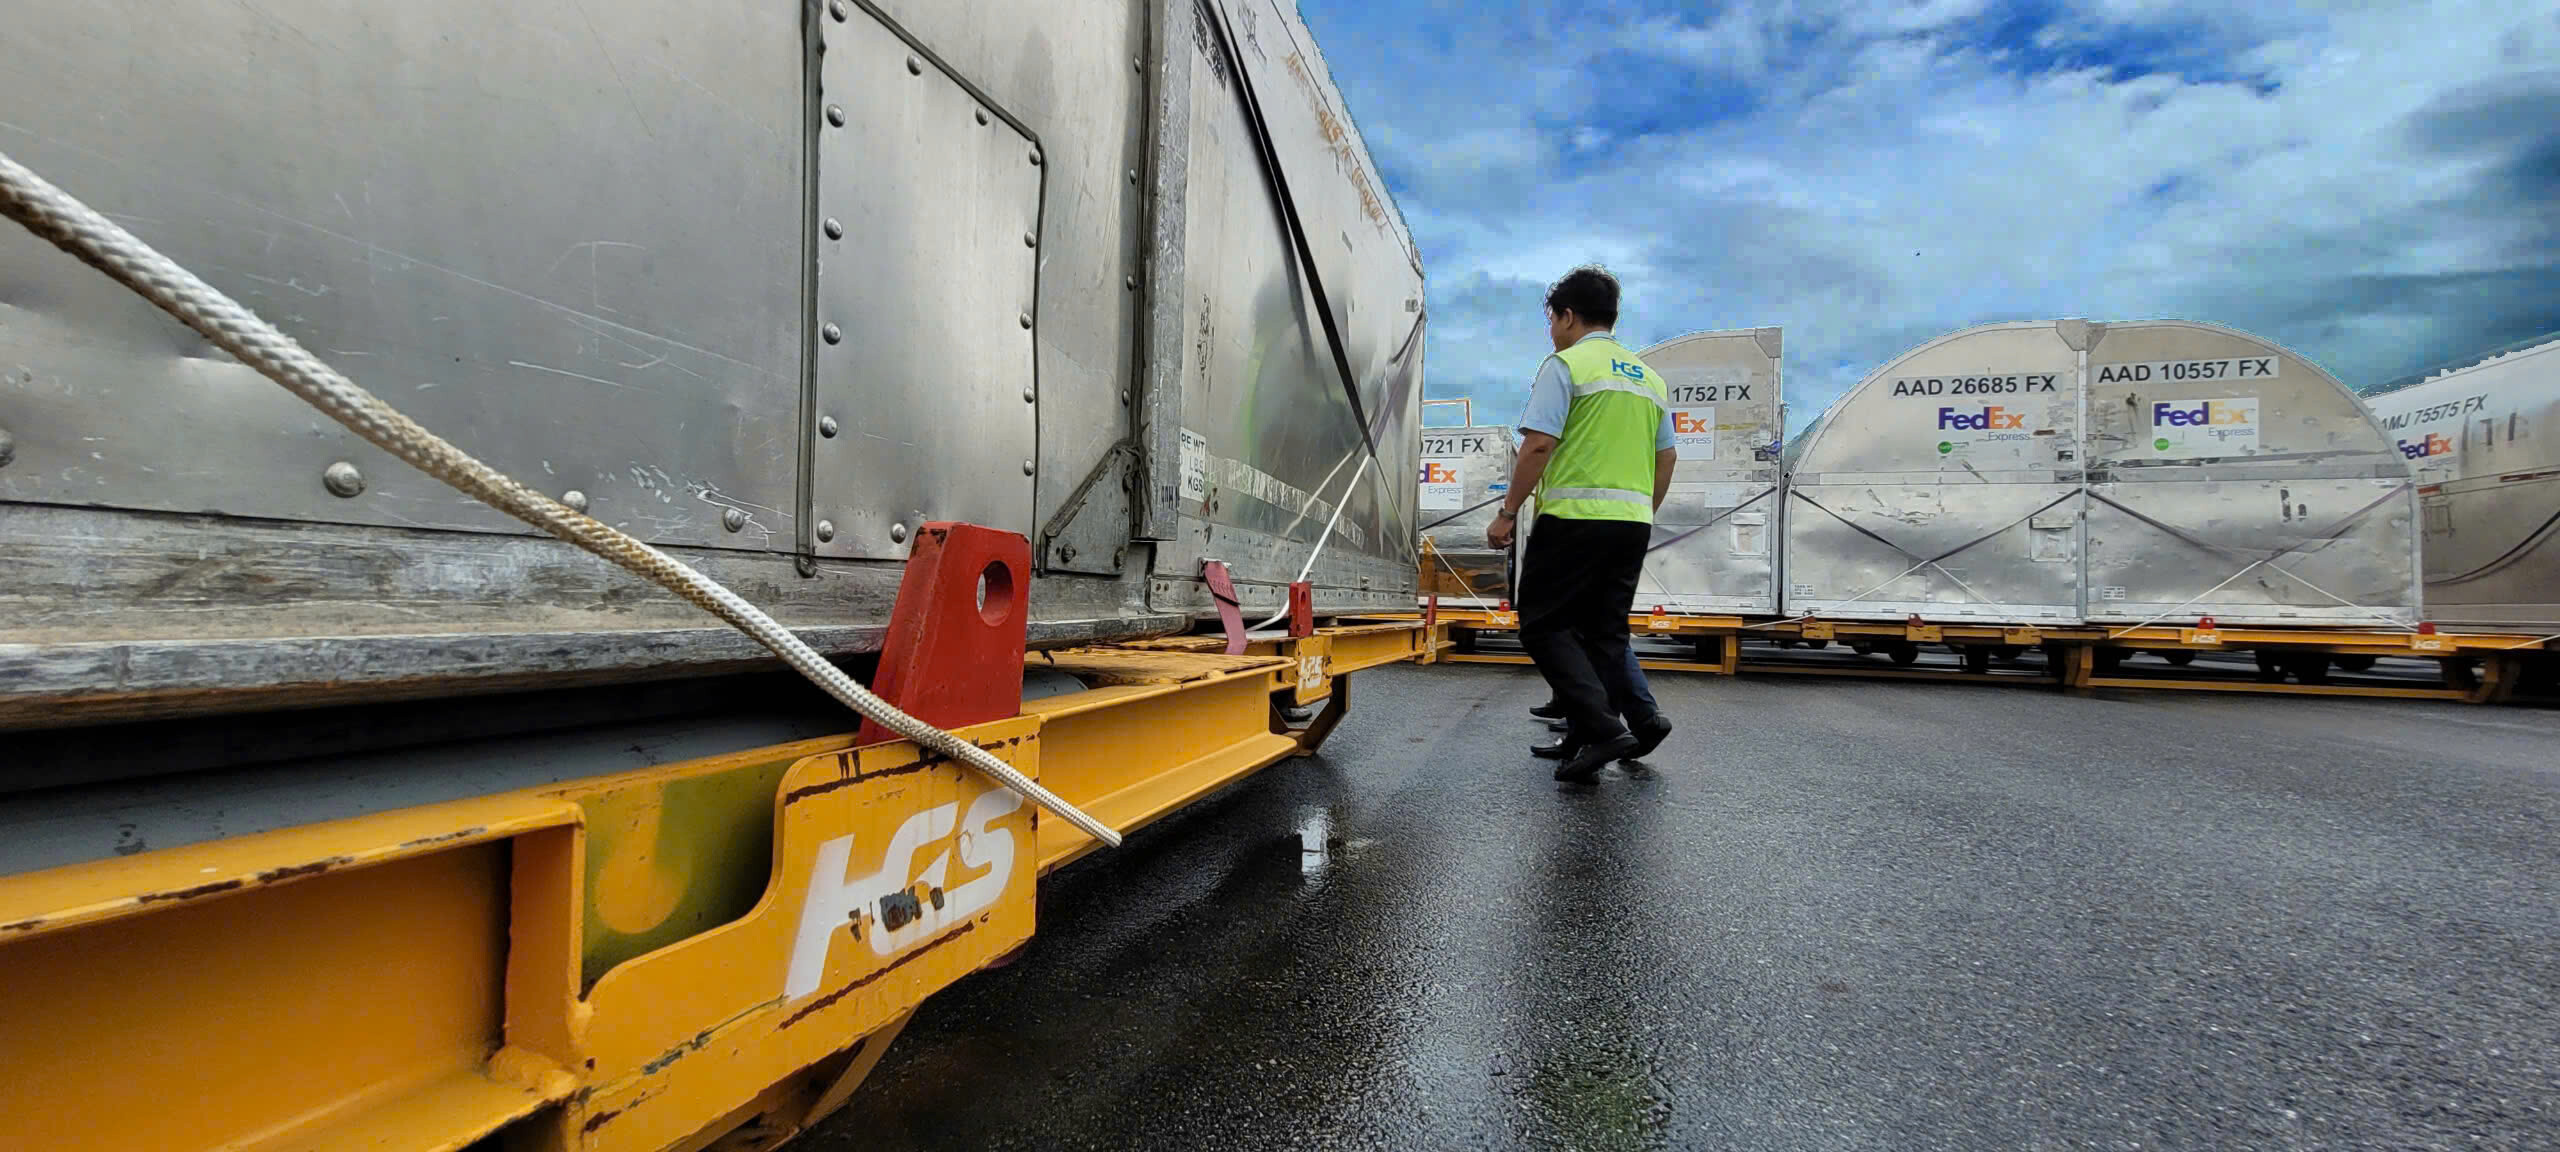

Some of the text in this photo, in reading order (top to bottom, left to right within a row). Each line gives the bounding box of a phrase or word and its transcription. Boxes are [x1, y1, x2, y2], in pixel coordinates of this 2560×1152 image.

[2098, 358, 2273, 383] AAD 10557 FX
[1672, 384, 1751, 402] 1752 FX
[1893, 375, 2056, 397] AAD 26685 FX
[1938, 406, 2024, 431] FedEx
[2154, 401, 2249, 427] FedEx
[2414, 400, 2461, 425] 75575
[2463, 393, 2488, 414] FX
[1675, 435, 1712, 446] Express
[1988, 431, 2031, 442] Express
[2208, 426, 2255, 439] Express
[1420, 437, 1484, 454] 721 FX
[2397, 432, 2453, 460] FedEx
[1187, 475, 1204, 493] KGS
[1428, 485, 1461, 496] Express
[783, 787, 1024, 1001] HGS
